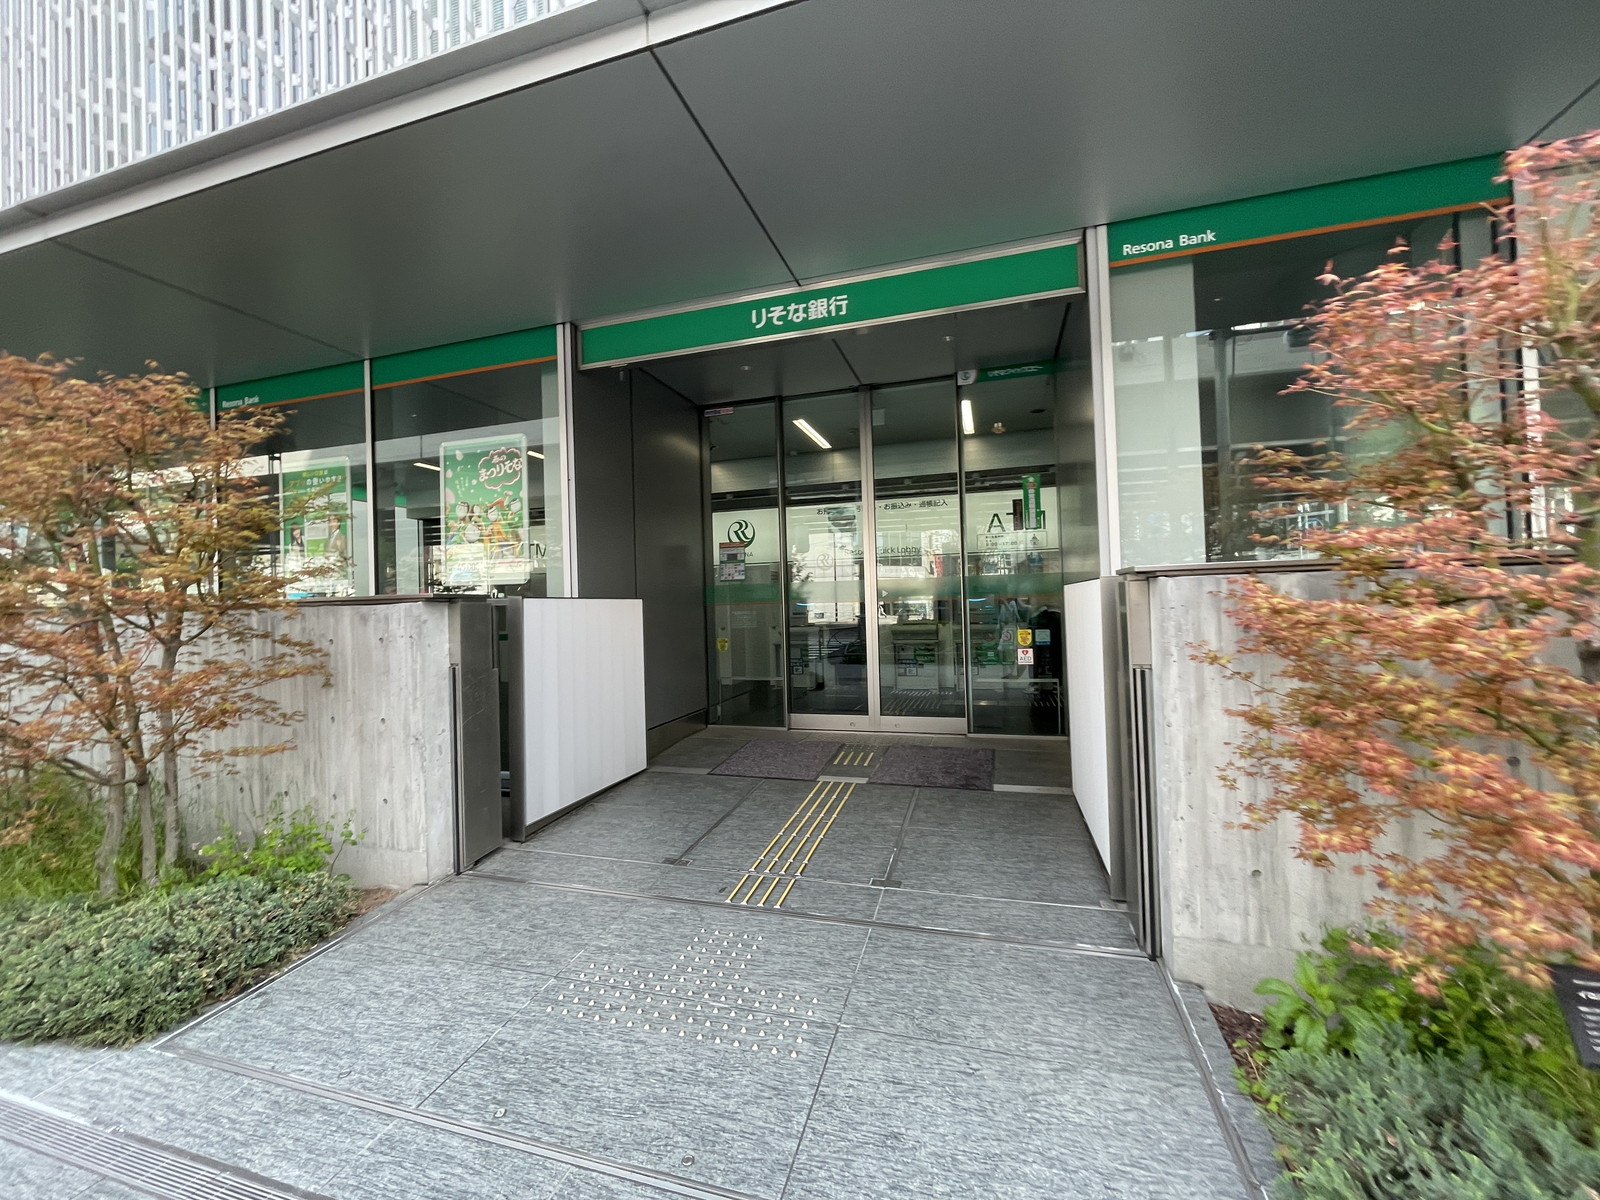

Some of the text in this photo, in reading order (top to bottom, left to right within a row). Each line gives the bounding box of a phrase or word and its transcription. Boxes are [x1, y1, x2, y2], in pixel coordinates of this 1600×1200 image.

[1122, 229, 1217, 256] Resona Bank
[751, 294, 849, 329] りそな銀行
